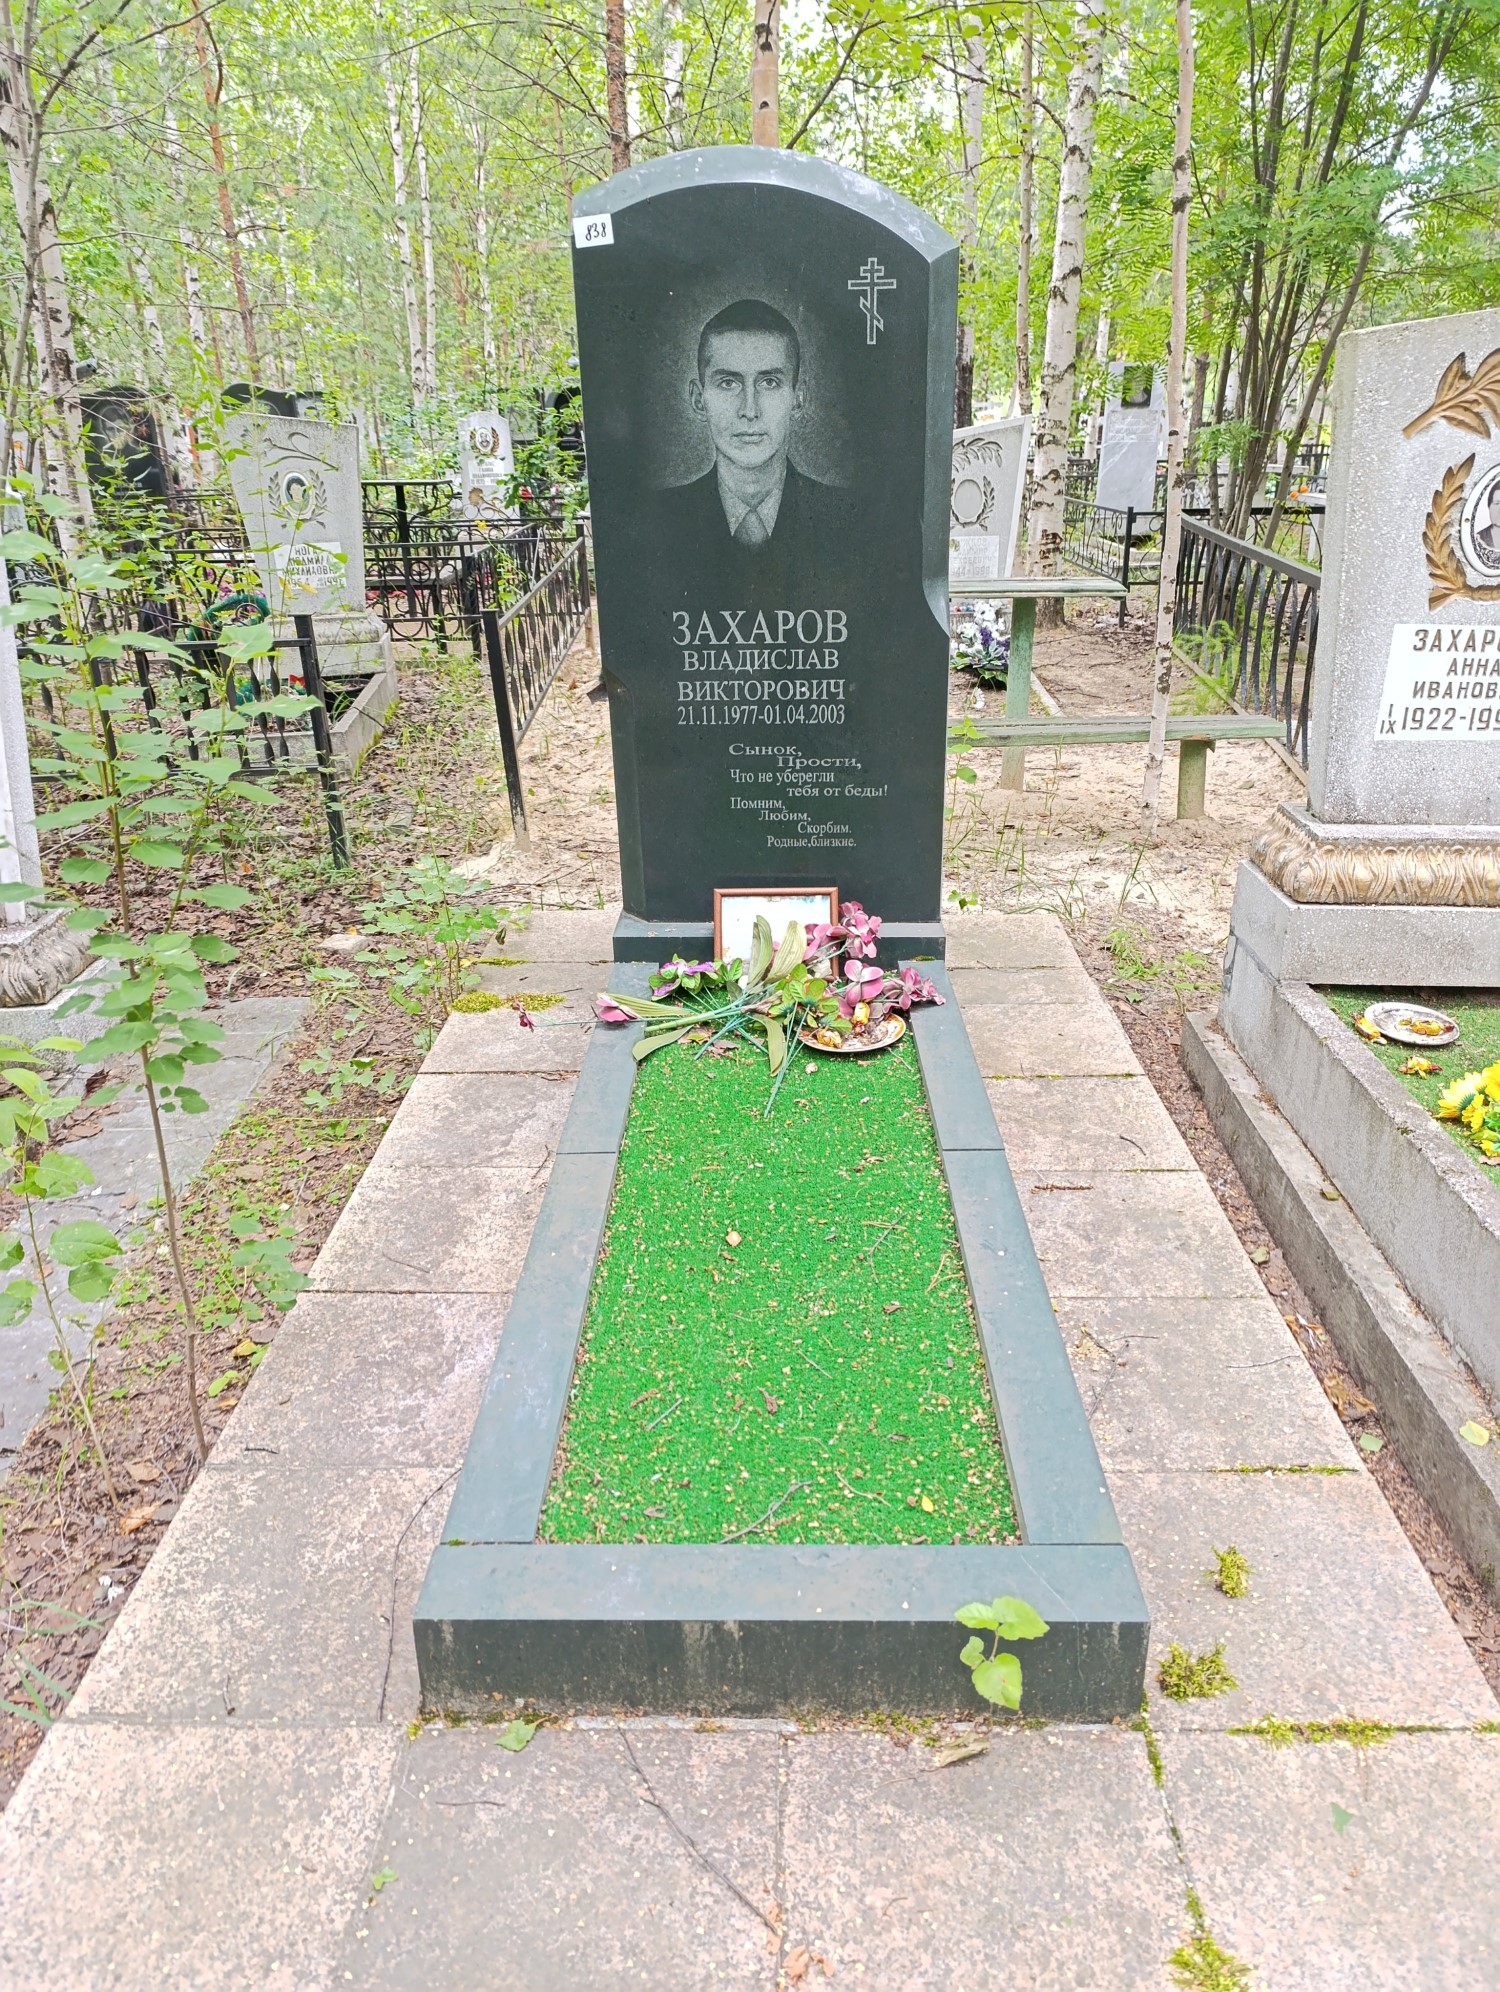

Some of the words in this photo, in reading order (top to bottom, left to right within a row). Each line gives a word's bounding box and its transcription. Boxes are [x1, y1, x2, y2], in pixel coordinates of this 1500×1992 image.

[585, 222, 607, 242] 838
[672, 609, 848, 646] ЗАХАРОВ
[1412, 628, 1500, 653] ЗАХАР
[682, 648, 839, 674] ВЛАДИСЛАВ
[1446, 657, 1500, 677] АННА
[677, 678, 846, 702] ВИКТОРОВИЧ
[1412, 681, 1500, 700] ИВАНОВ
[677, 703, 846, 725] 21.11.1977-01.04.2003
[728, 743, 802, 757] Сынок,
[776, 755, 862, 770] Прости,
[730, 769, 754, 783] Что
[758, 772, 773, 783] не
[776, 768, 834, 786] уберегли
[786, 784, 820, 797] тебя
[823, 787, 842, 797] от
[844, 784, 888, 798] беды!
[730, 797, 786, 811] Помним,
[758, 810, 812, 822] Любим,
[797, 821, 852, 836] Скорбим.
